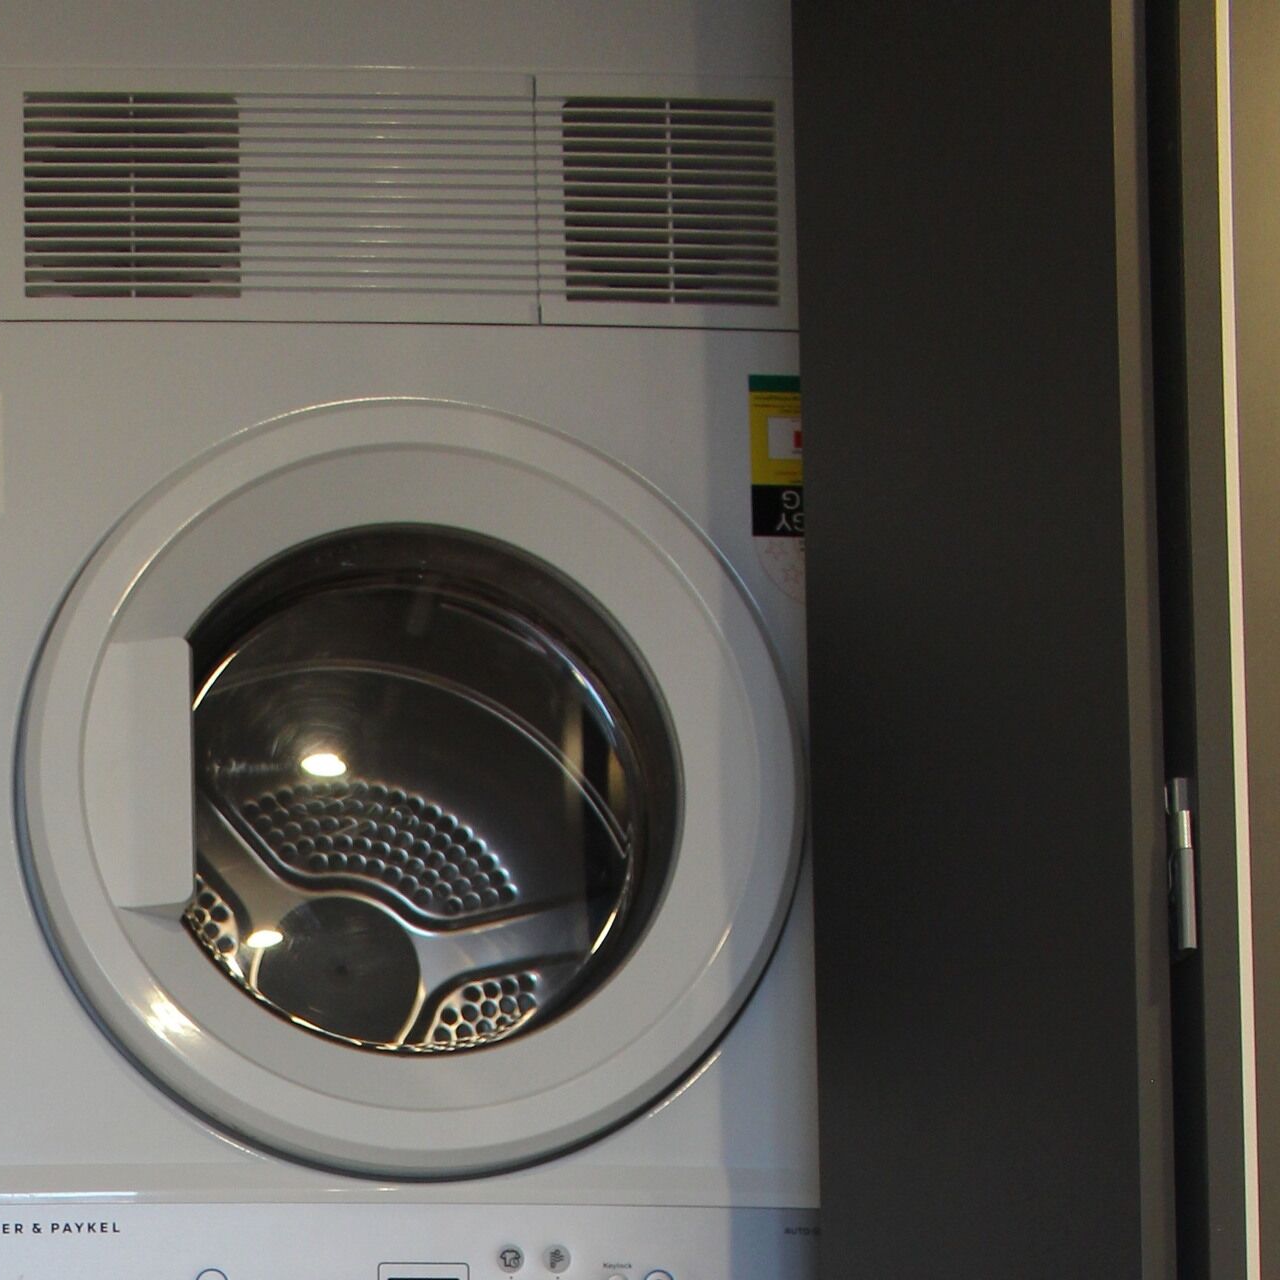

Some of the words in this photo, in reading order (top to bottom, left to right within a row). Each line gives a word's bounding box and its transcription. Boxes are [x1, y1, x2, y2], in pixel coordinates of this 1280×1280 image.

[32, 1223, 42, 1233] &
[51, 1222, 121, 1233] PAYKEL
[602, 1262, 632, 1270] Keylock
